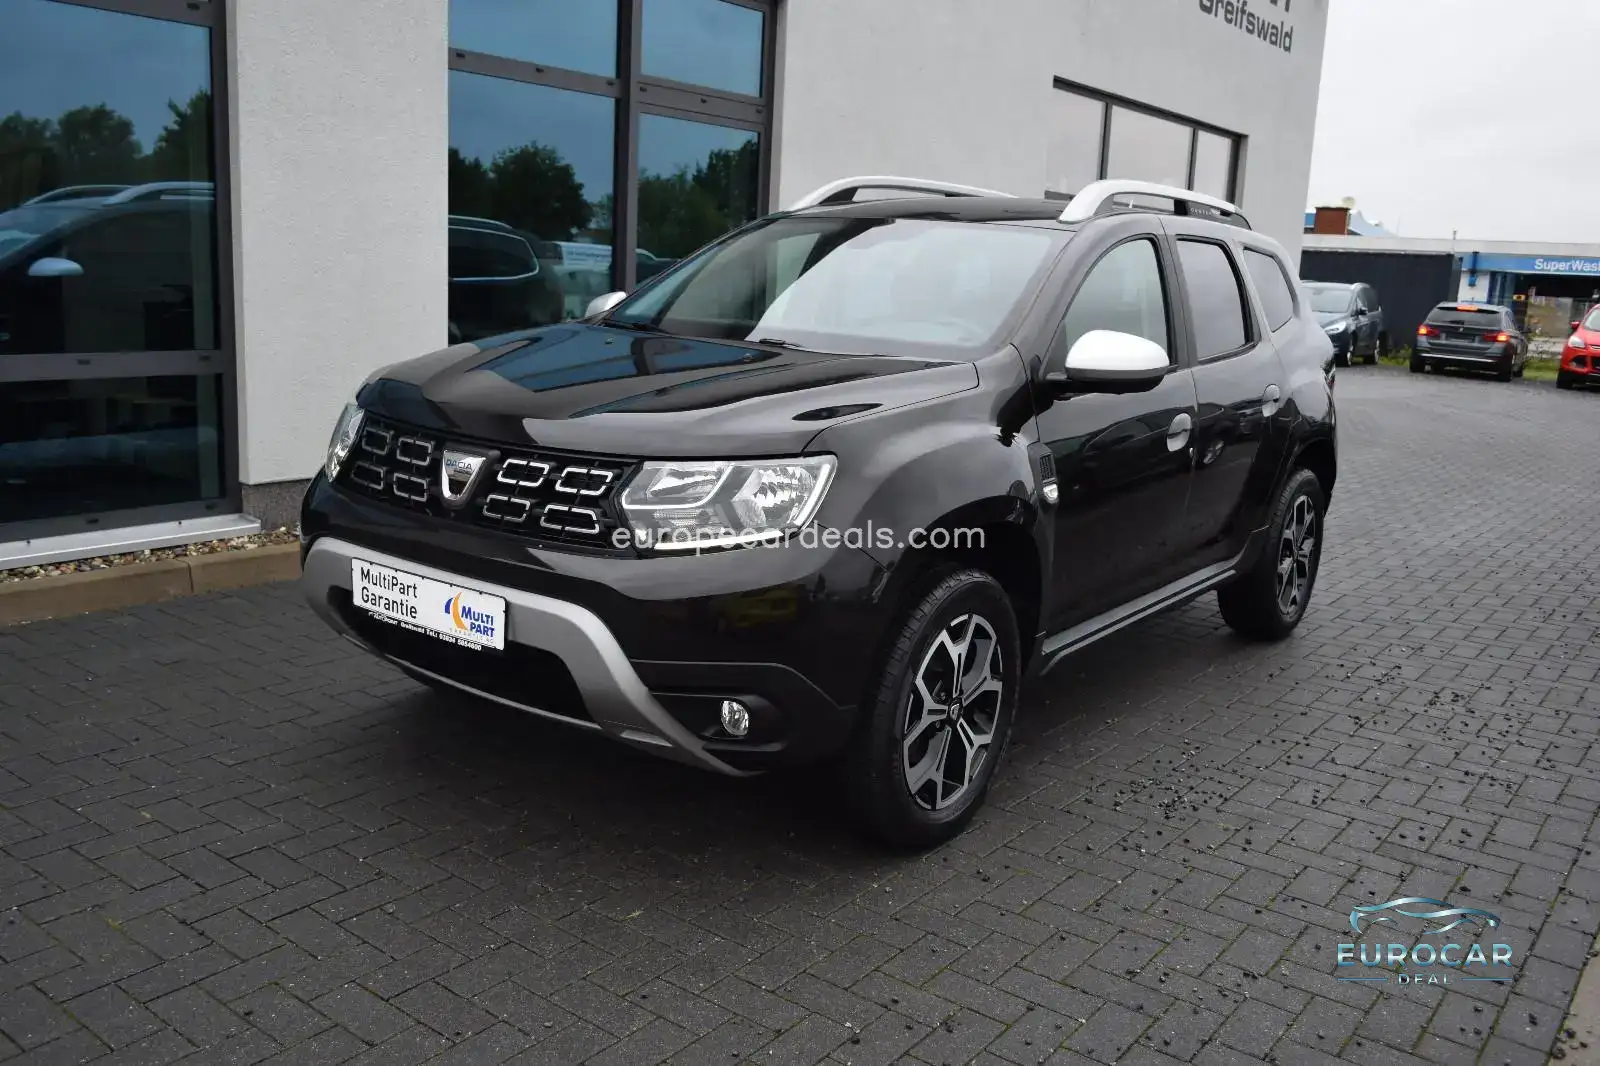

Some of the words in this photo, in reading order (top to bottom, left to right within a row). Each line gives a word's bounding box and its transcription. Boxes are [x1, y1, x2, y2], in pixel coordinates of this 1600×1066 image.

[1534, 258, 1600, 272] SuperWas
[446, 459, 472, 470] DACIA
[360, 566, 417, 599] MultiPart
[361, 586, 417, 619] Garantie
[461, 605, 494, 626] MULTI
[470, 621, 495, 638] PART
